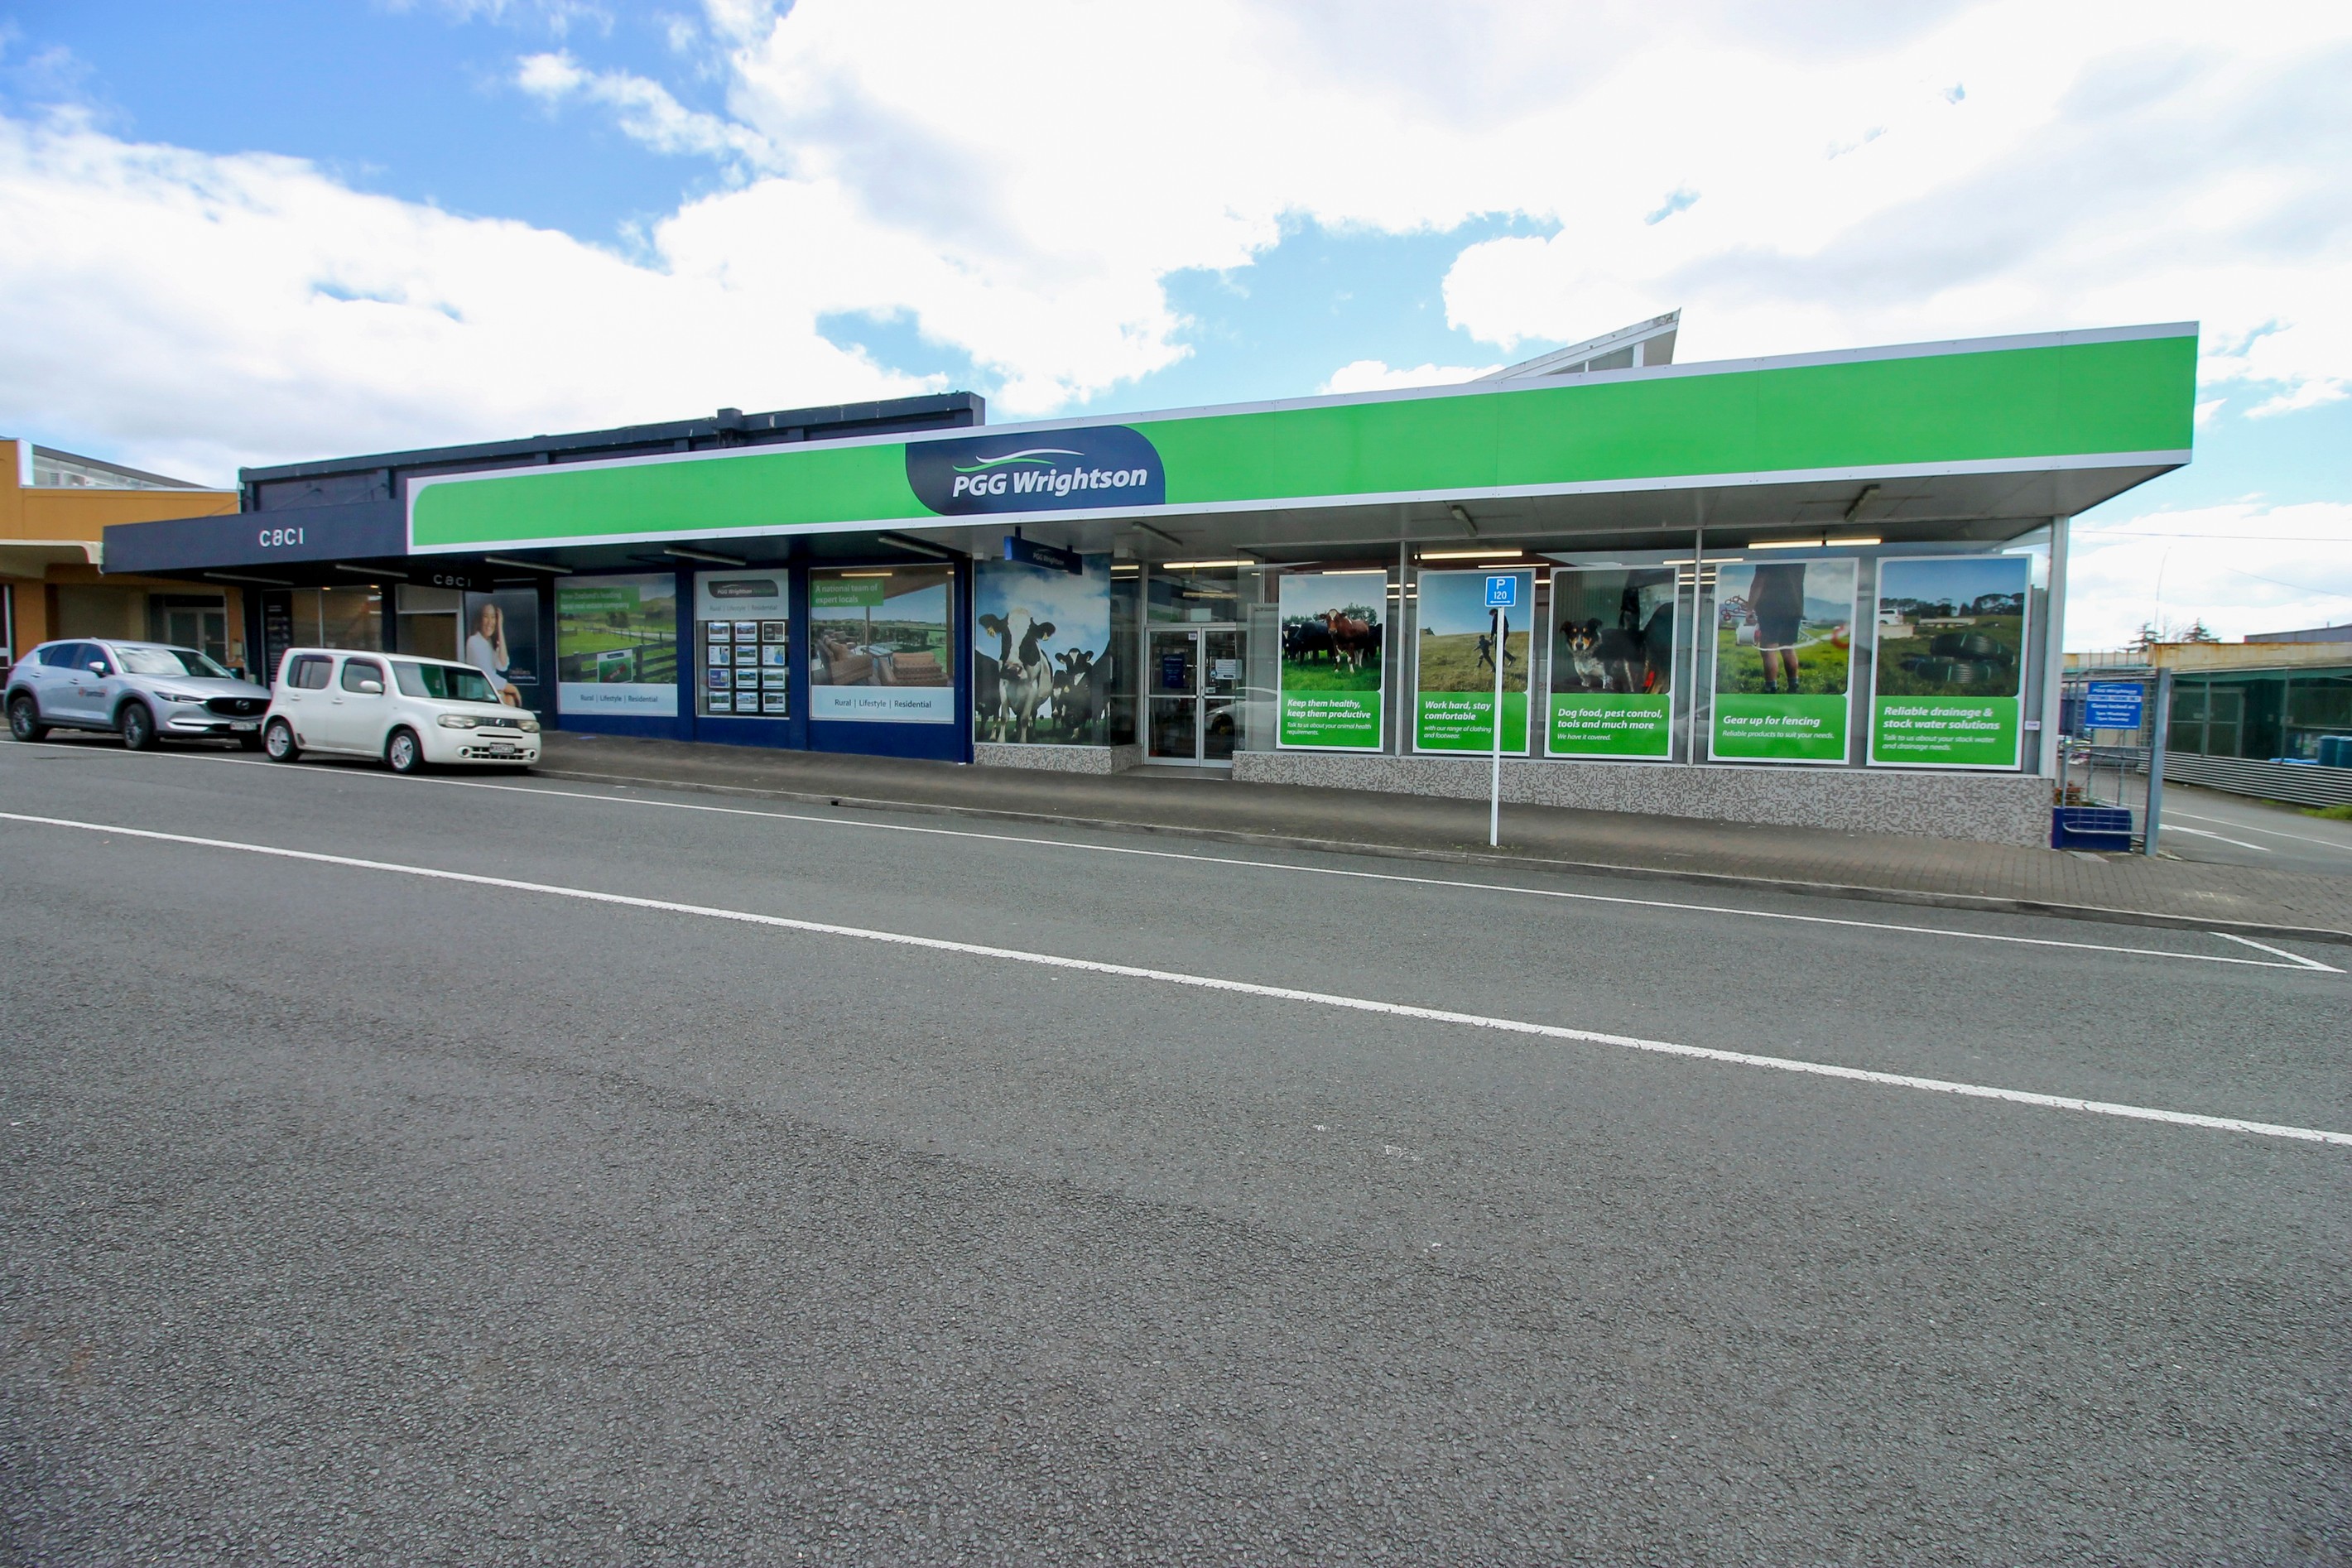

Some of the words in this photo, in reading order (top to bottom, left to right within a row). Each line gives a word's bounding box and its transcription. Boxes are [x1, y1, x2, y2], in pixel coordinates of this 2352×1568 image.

[953, 473, 1007, 497] PGG
[1012, 467, 1147, 497] Wrightson
[822, 584, 850, 593] national
[1496, 579, 1506, 589] P
[1493, 591, 1507, 599] 120
[815, 596, 838, 605] expert
[859, 700, 886, 709] Lifestyle
[1287, 700, 1306, 708] Keep
[1308, 699, 1327, 707] them
[1330, 700, 1360, 709] healthy,
[1449, 701, 1470, 710] hard,
[1473, 702, 1491, 712] stay
[1287, 709, 1306, 719] keep
[1328, 710, 1371, 719] productive
[1425, 712, 1476, 720] comfortable
[1558, 709, 1577, 718] Dog
[1579, 709, 1602, 718] food,
[1604, 709, 1624, 719] pest
[1627, 709, 1662, 719] control,
[1884, 707, 1929, 716] Reliable
[1931, 708, 1982, 719] drainage
[1983, 708, 1993, 717] &
[1558, 719, 1580, 728] tools
[1582, 720, 1602, 729] and
[1602, 720, 1627, 729] much
[1724, 716, 1748, 724] Gear
[1749, 718, 1763, 726] up
[1765, 716, 1780, 725] for
[1782, 716, 1821, 728] fencing
[1883, 719, 1912, 728] stock
[1948, 720, 2000, 729] solutions
